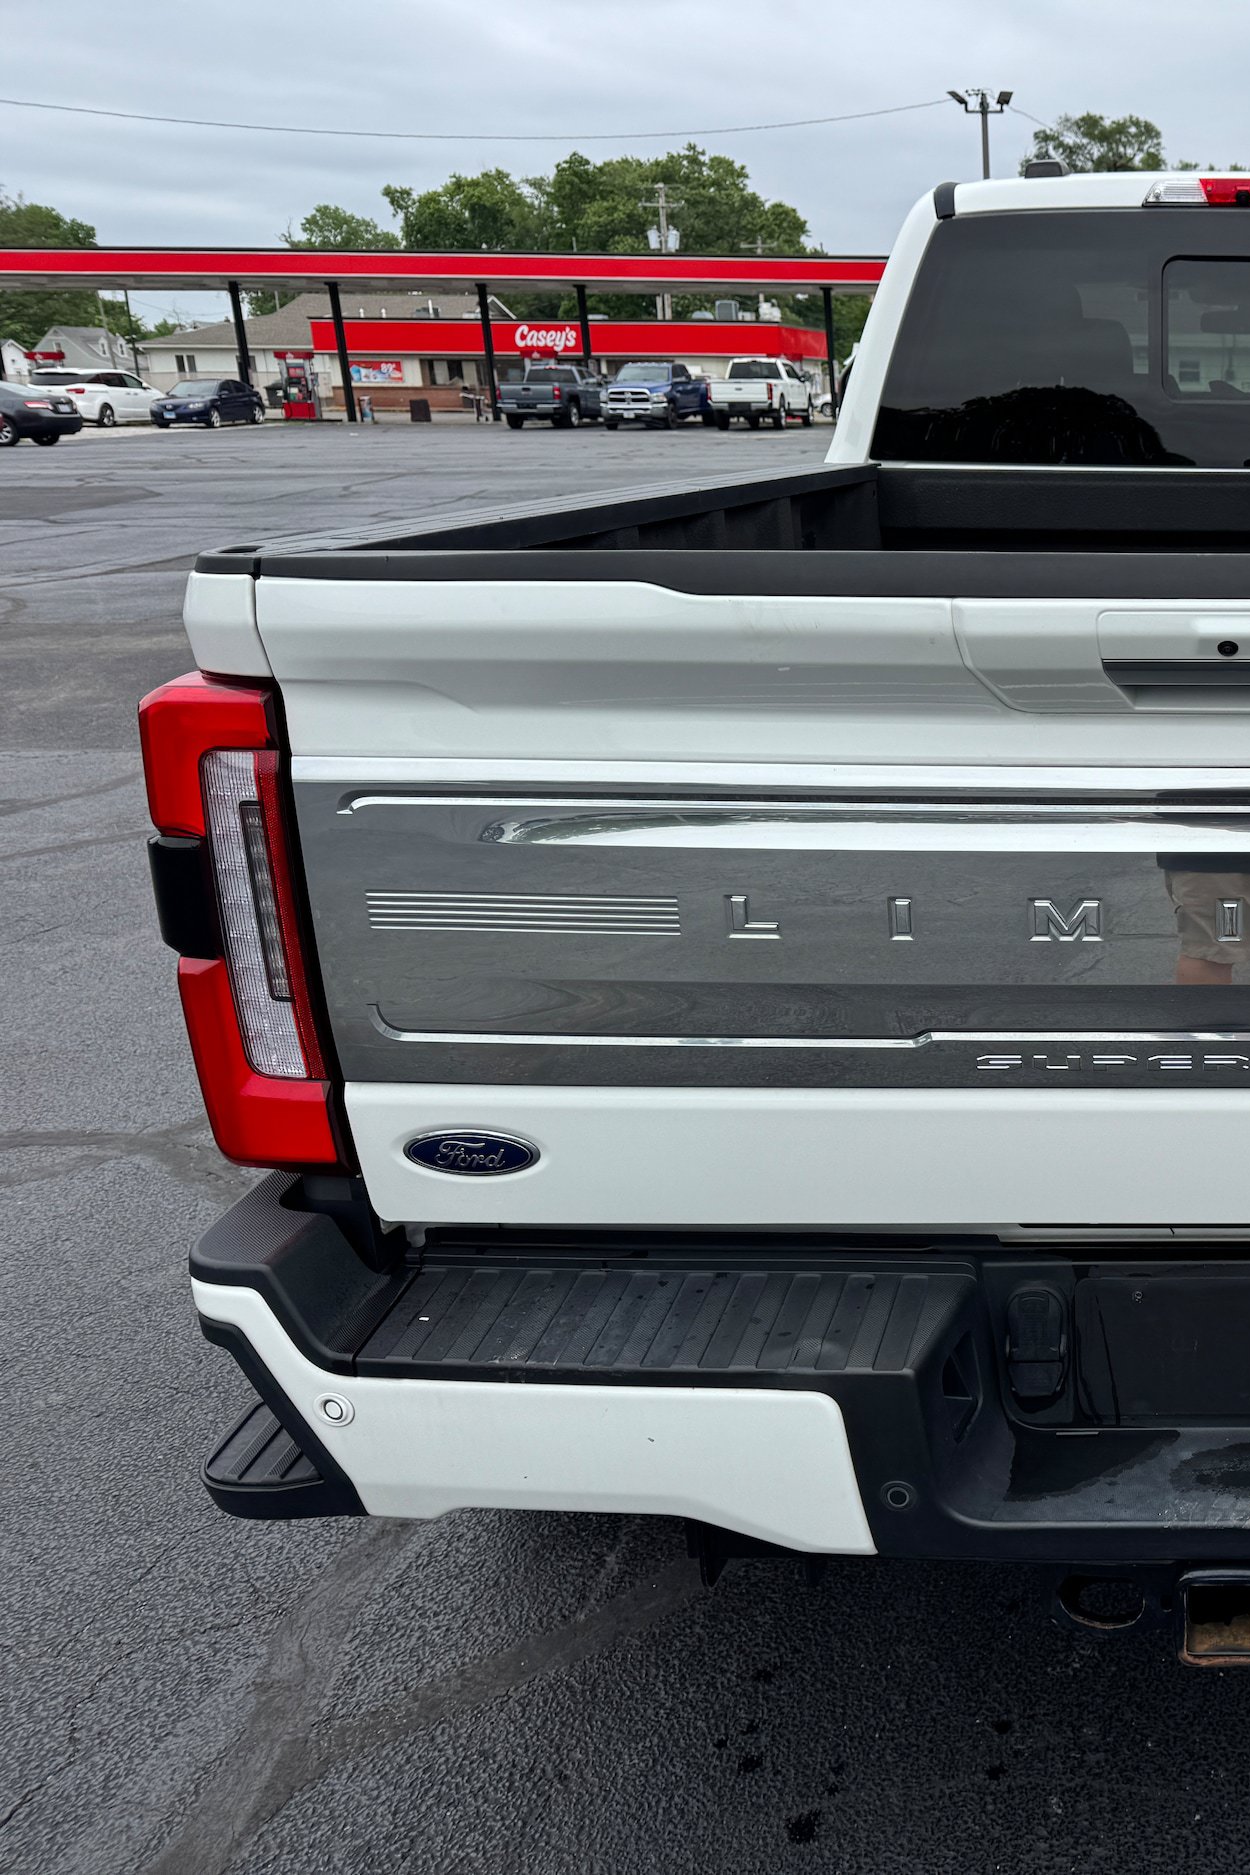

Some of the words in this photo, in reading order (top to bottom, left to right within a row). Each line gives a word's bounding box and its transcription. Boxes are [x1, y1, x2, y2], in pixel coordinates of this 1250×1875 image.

[515, 325, 577, 352] Casey's
[976, 1054, 1250, 1070] SUPER
[435, 1140, 505, 1168] Ford
